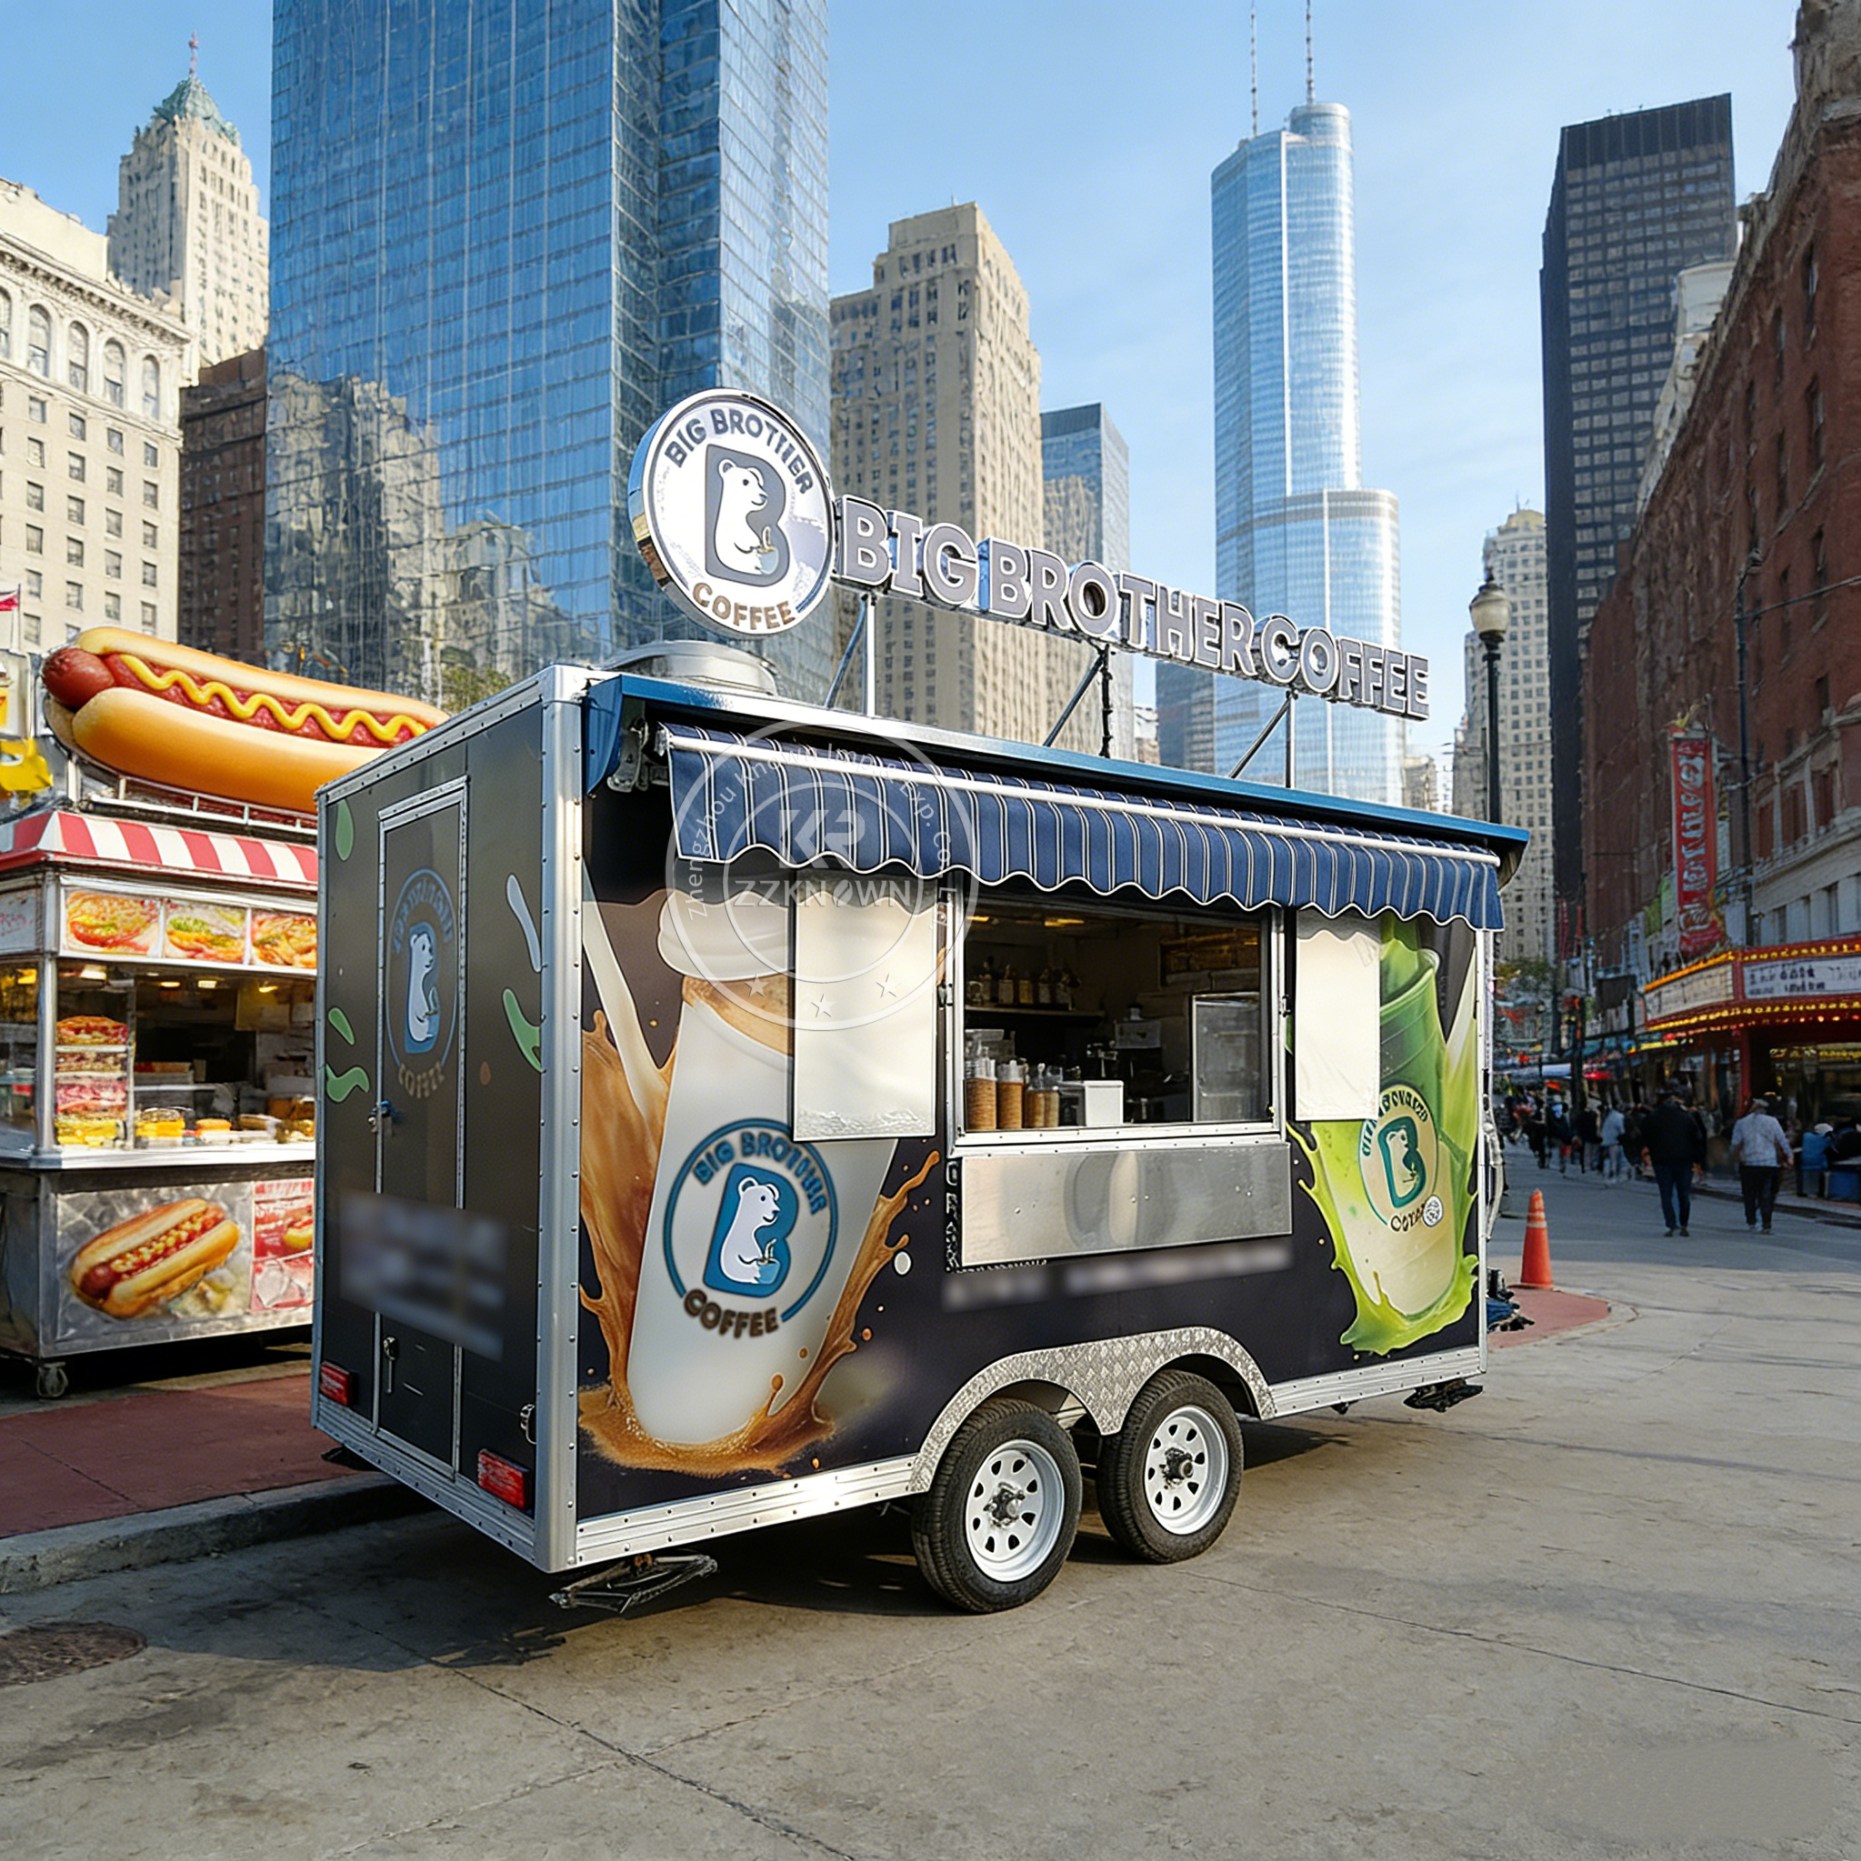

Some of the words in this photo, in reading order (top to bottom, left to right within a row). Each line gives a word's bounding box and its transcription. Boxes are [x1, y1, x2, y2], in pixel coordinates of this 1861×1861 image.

[664, 418, 707, 468] BIG
[692, 582, 796, 630] COFFEE
[841, 494, 979, 606] BIG
[981, 536, 1257, 677] BROTHER
[1257, 614, 1430, 721] COFFEE
[683, 1288, 779, 1339] COFFEE
